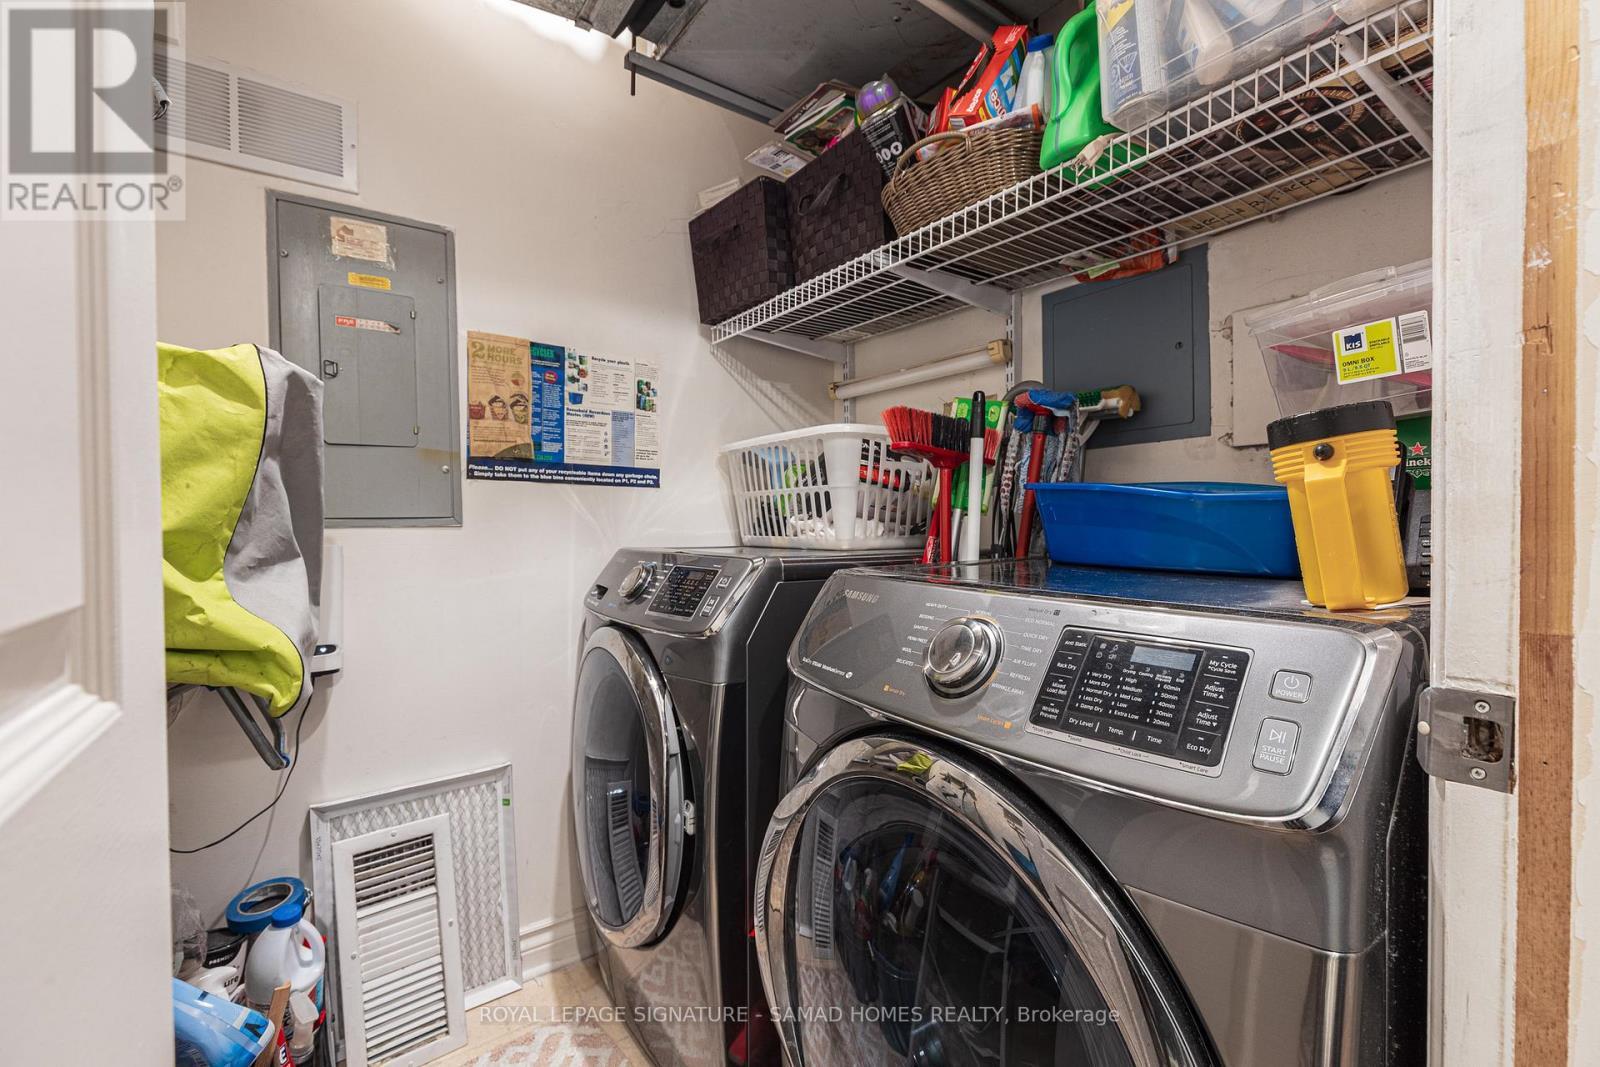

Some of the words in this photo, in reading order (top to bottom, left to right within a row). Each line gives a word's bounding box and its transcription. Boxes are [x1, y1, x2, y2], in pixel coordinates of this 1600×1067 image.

[1346, 340, 1361, 350] KIS
[472, 341, 485, 359] 2
[487, 344, 516, 356] MORE
[487, 354, 522, 364] HOURS
[843, 589, 880, 604] SAMSUNG
[1220, 661, 1237, 669] Cycle
[1009, 672, 1030, 681] REFRESH
[1163, 684, 1181, 692] 60min
[1204, 684, 1224, 692] Adjust
[1276, 689, 1304, 698] POWER
[1042, 706, 1059, 714] Wrinkle
[1155, 710, 1173, 718] 30min
[1197, 712, 1218, 720] Adjust
[1079, 720, 1094, 728] Level
[1152, 719, 1170, 727] 20min
[1196, 718, 1211, 727] Time
[1108, 727, 1124, 736] Temp.
[1147, 736, 1162, 744] Time
[1199, 746, 1211, 754] Dry
[1262, 745, 1287, 755] START
[1260, 753, 1285, 764] PAUSE
